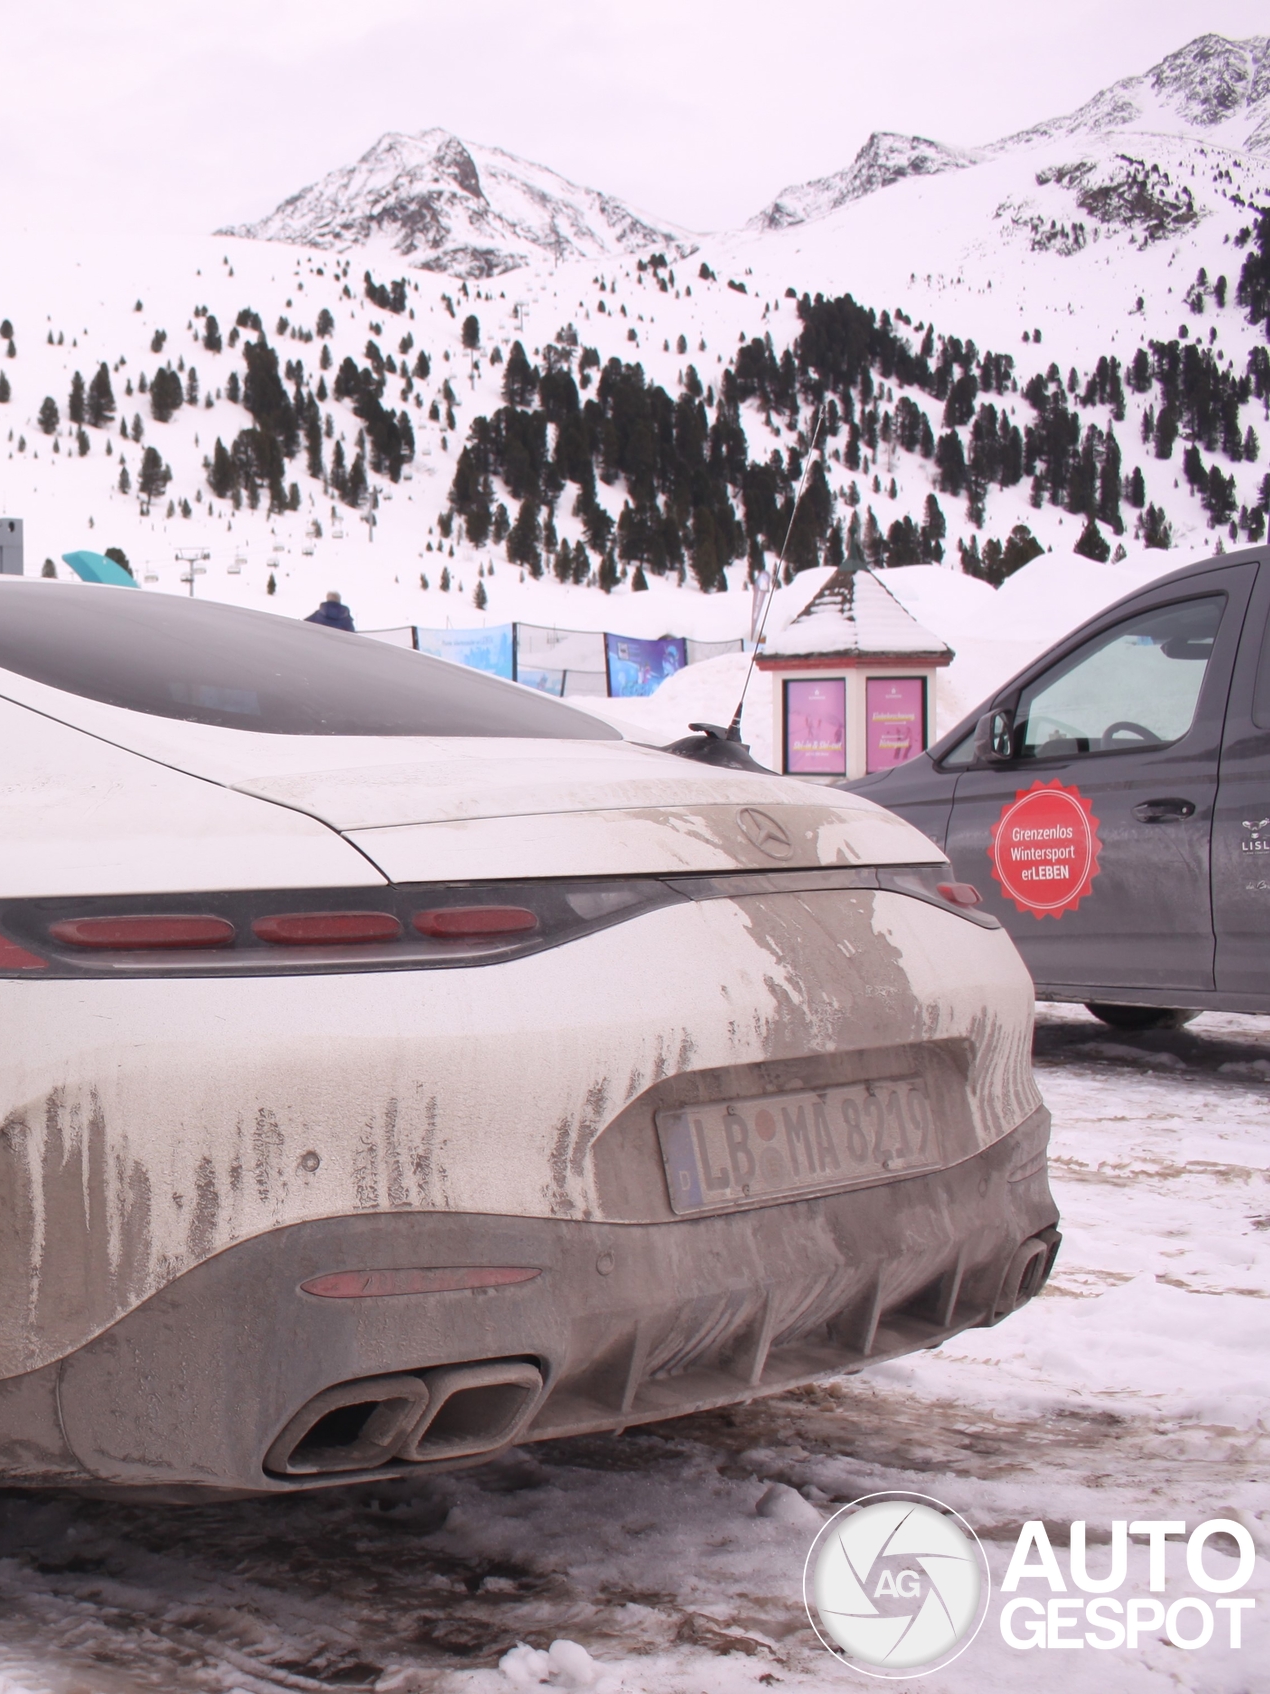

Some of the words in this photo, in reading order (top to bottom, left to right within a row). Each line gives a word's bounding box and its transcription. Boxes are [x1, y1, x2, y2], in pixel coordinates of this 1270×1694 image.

[1012, 824, 1073, 841] Grenzenlos
[1011, 845, 1075, 862] Wintersport
[1021, 865, 1069, 880] erLEBEN
[694, 1114, 756, 1191] LB
[781, 1102, 841, 1177] MA
[841, 1087, 930, 1163] 8219
